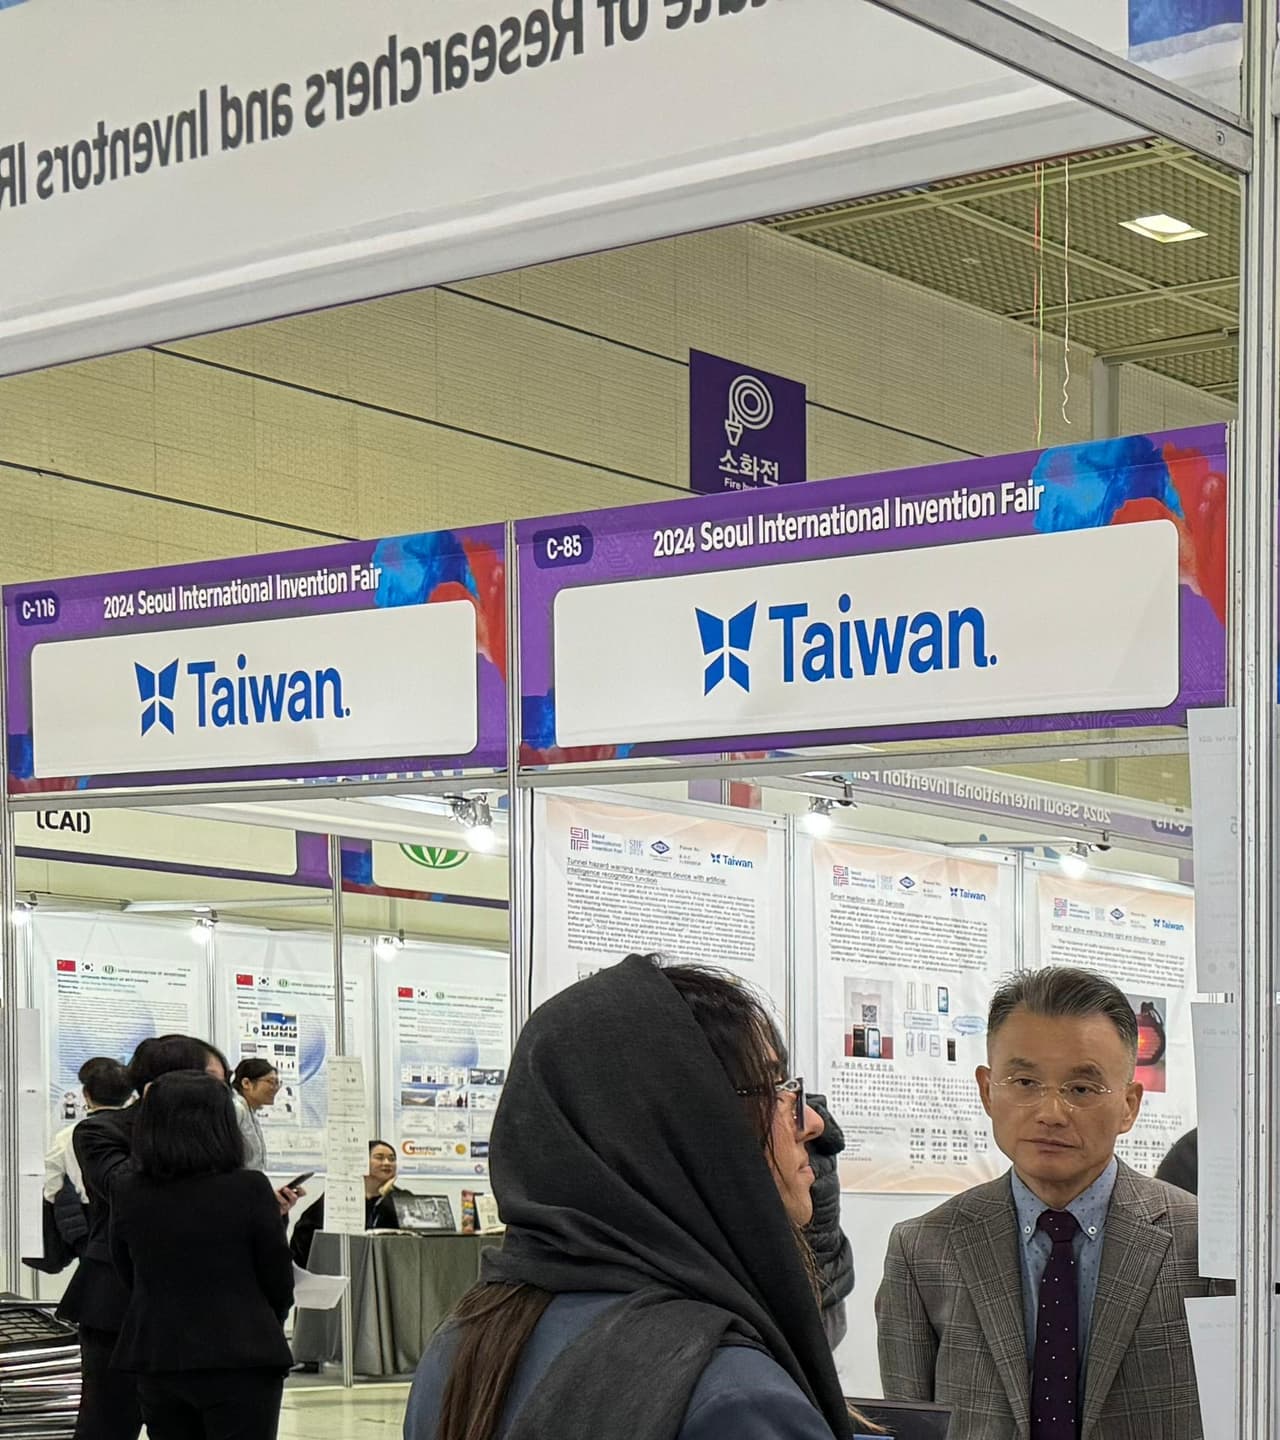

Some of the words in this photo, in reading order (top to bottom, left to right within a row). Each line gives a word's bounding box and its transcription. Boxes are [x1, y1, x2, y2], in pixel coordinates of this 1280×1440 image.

[718, 449, 779, 487] 소화전
[724, 477, 741, 490] Fire
[653, 530, 695, 558] 2024
[699, 521, 753, 552] Seoul
[757, 499, 890, 546] International
[894, 488, 996, 531] Invention
[1000, 479, 1045, 515] Fair
[546, 534, 582, 560] C-85
[103, 594, 135, 620] 2024
[137, 587, 177, 615] Seoul
[179, 574, 273, 613] International
[275, 567, 347, 602] Invention
[350, 563, 382, 592] Fair
[22, 599, 56, 620] C-116
[722, 854, 754, 869] Taiwan
[959, 887, 987, 901] Taiwan
